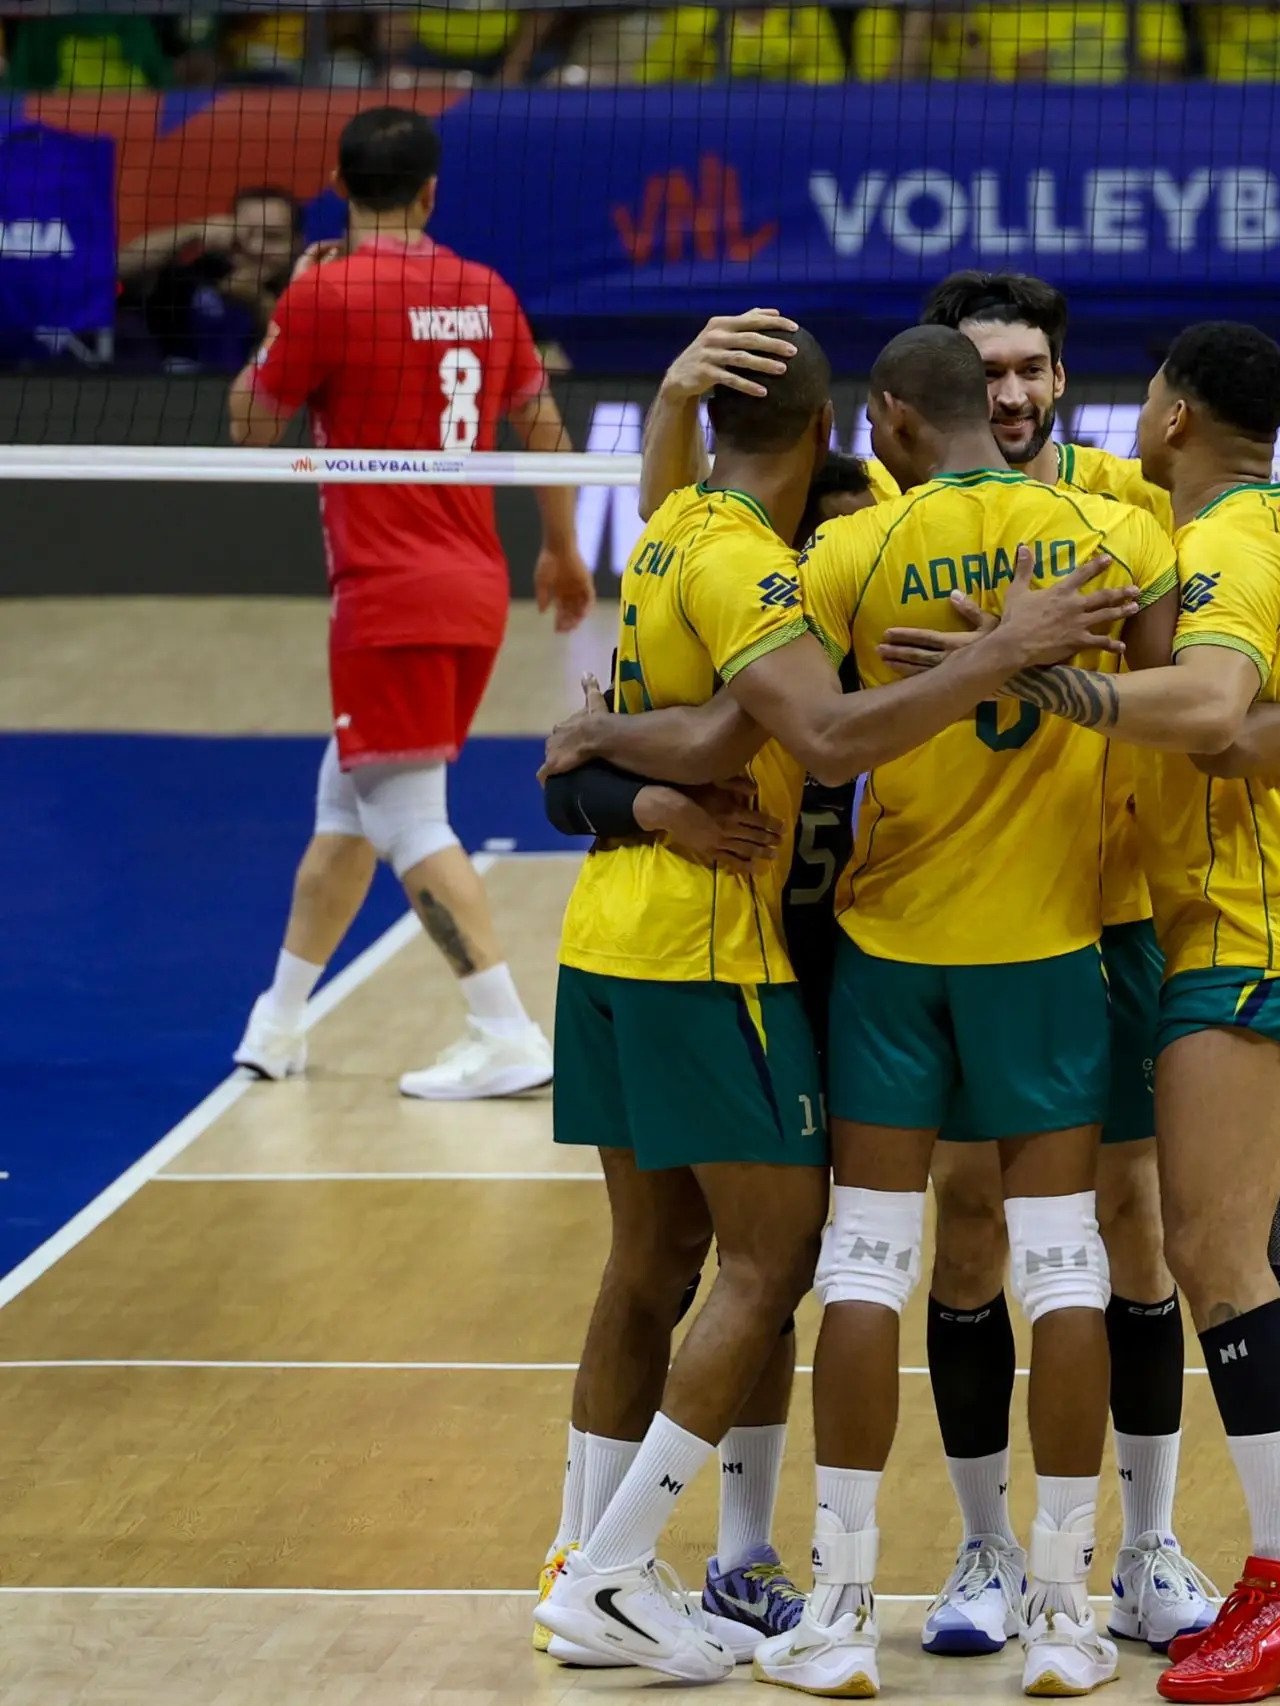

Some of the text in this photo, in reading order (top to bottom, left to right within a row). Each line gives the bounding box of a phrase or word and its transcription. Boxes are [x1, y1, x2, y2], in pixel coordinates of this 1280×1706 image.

[438, 347, 482, 453] 8
[325, 459, 429, 473] VOLLEYBALL
[847, 1236, 912, 1273] N1
[1026, 1245, 1088, 1275] N1
[1219, 1338, 1249, 1365] N1
[722, 1461, 744, 1475] N1
[659, 1473, 685, 1496] N1
